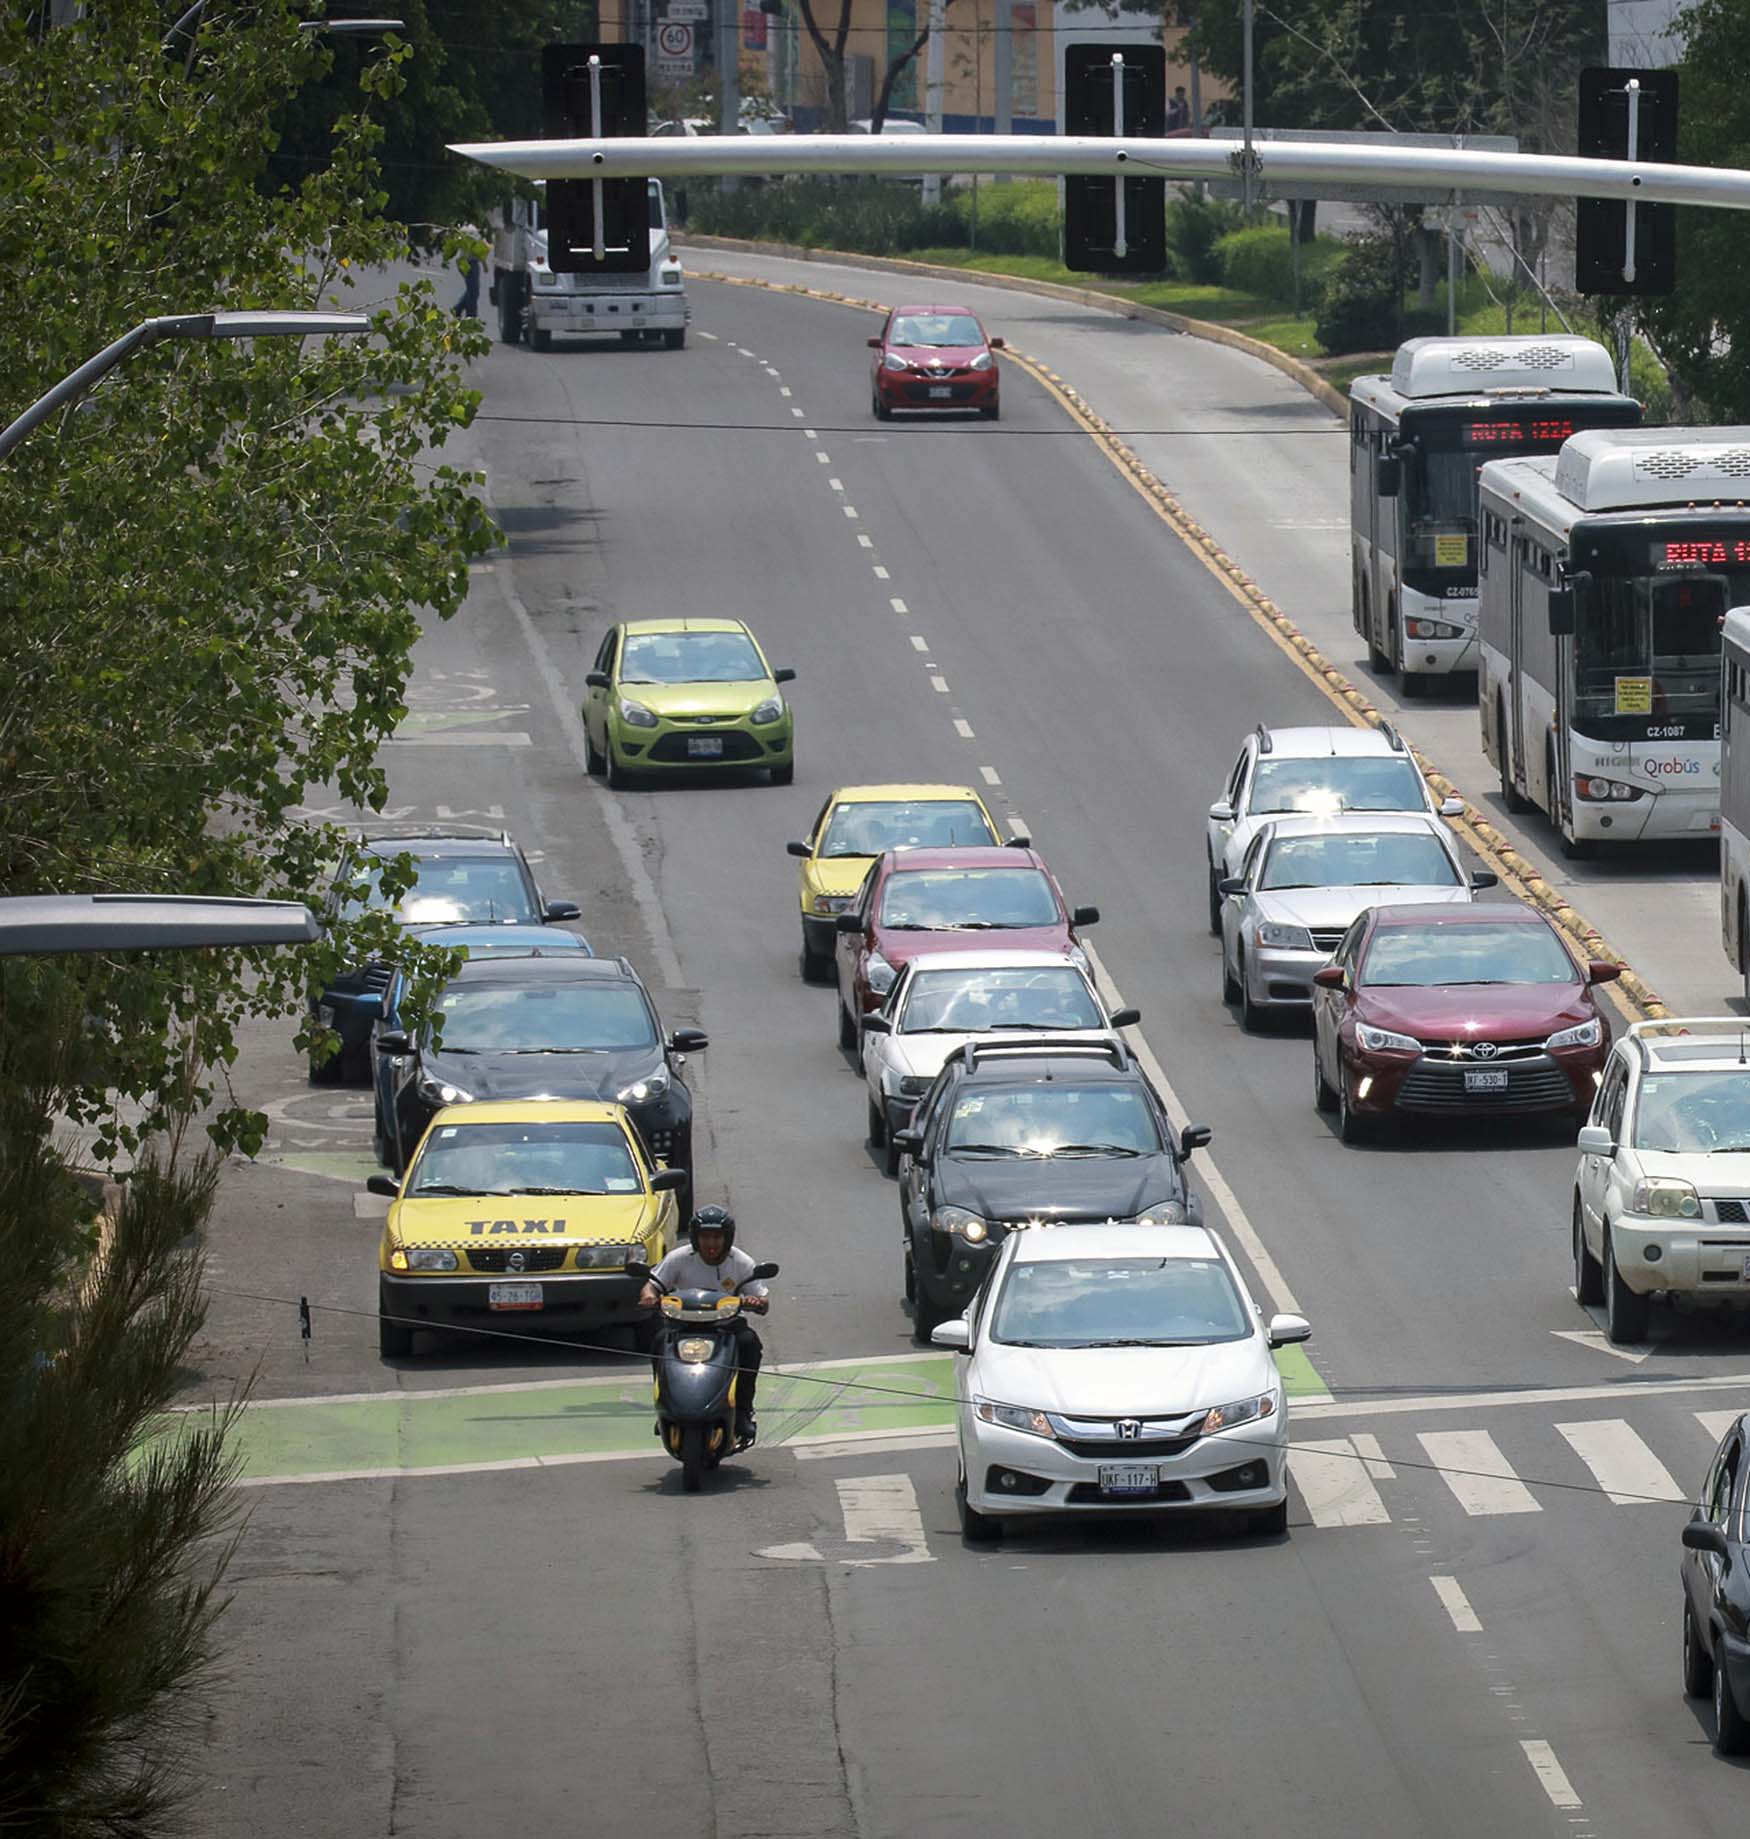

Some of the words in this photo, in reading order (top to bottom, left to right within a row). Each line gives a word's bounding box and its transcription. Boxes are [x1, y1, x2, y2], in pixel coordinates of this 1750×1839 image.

[1472, 422, 1523, 440] RUTA
[1666, 542, 1726, 562] RUTA
[1644, 757, 1700, 777] Qrobús
[464, 1219, 566, 1235] TAXI
